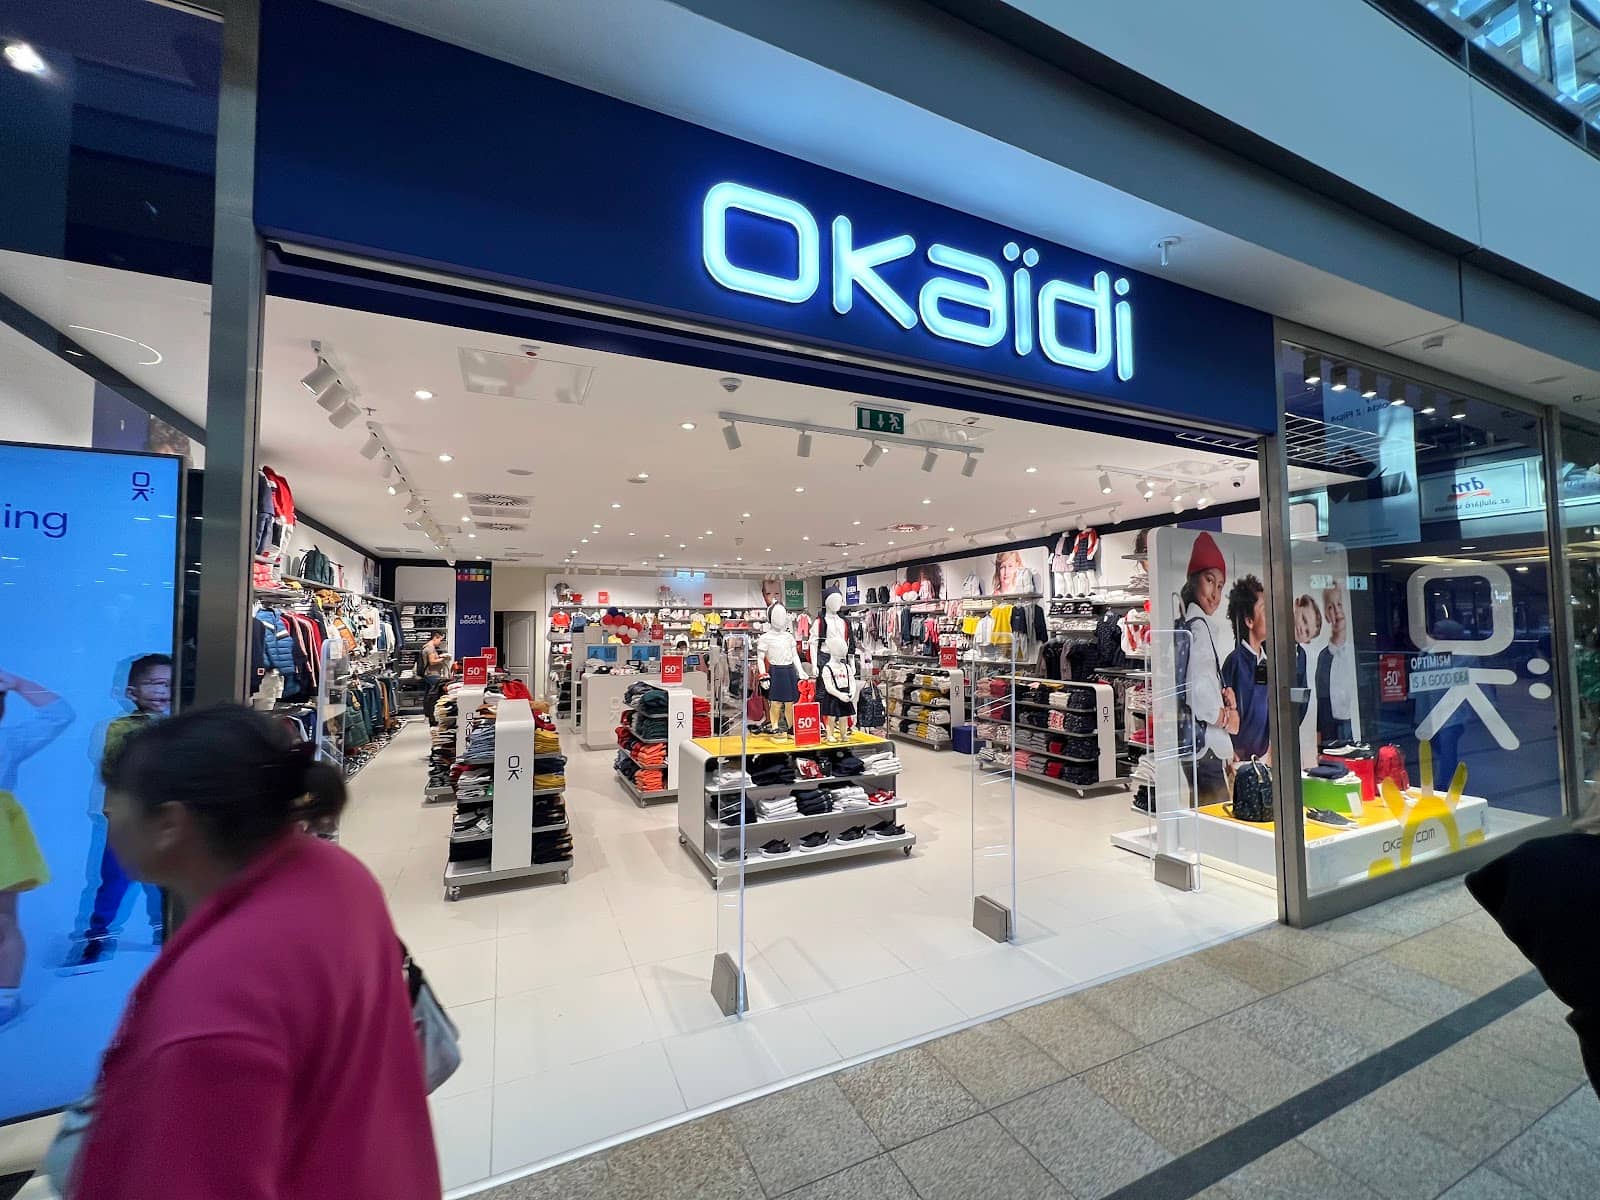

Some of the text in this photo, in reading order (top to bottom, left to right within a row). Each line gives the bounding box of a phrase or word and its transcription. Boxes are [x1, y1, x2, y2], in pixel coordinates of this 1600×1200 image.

[4, 504, 67, 538] ing
[1410, 654, 1451, 670] OPTIMISM
[1420, 674, 1427, 687] A
[1428, 672, 1453, 686] GOOD
